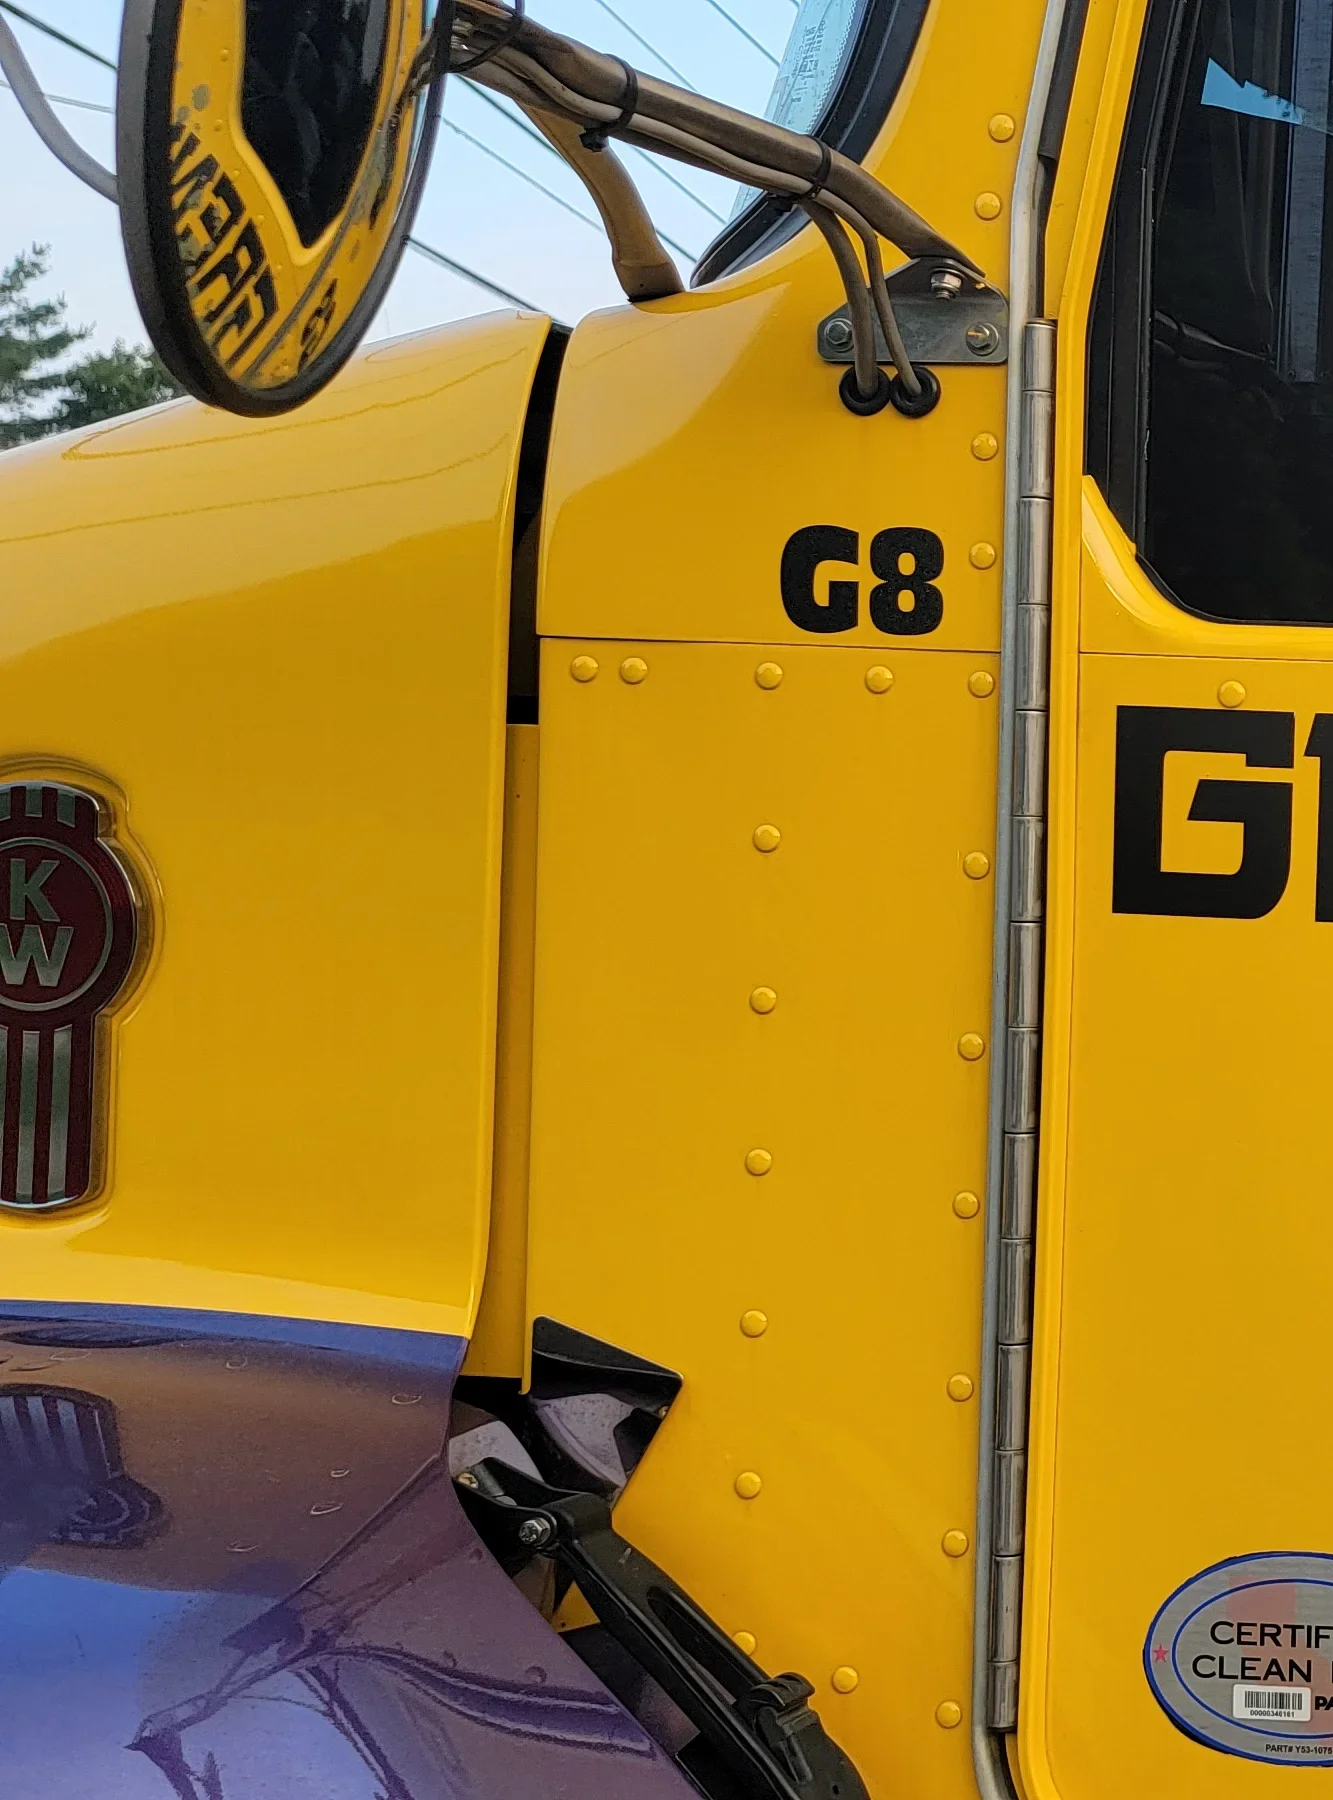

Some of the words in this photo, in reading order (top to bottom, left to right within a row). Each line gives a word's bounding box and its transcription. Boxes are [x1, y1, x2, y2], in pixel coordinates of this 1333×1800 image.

[780, 524, 944, 636] G8
[1190, 1653, 1313, 1683] CLEAN
[1264, 1742, 1294, 1755] PART#
